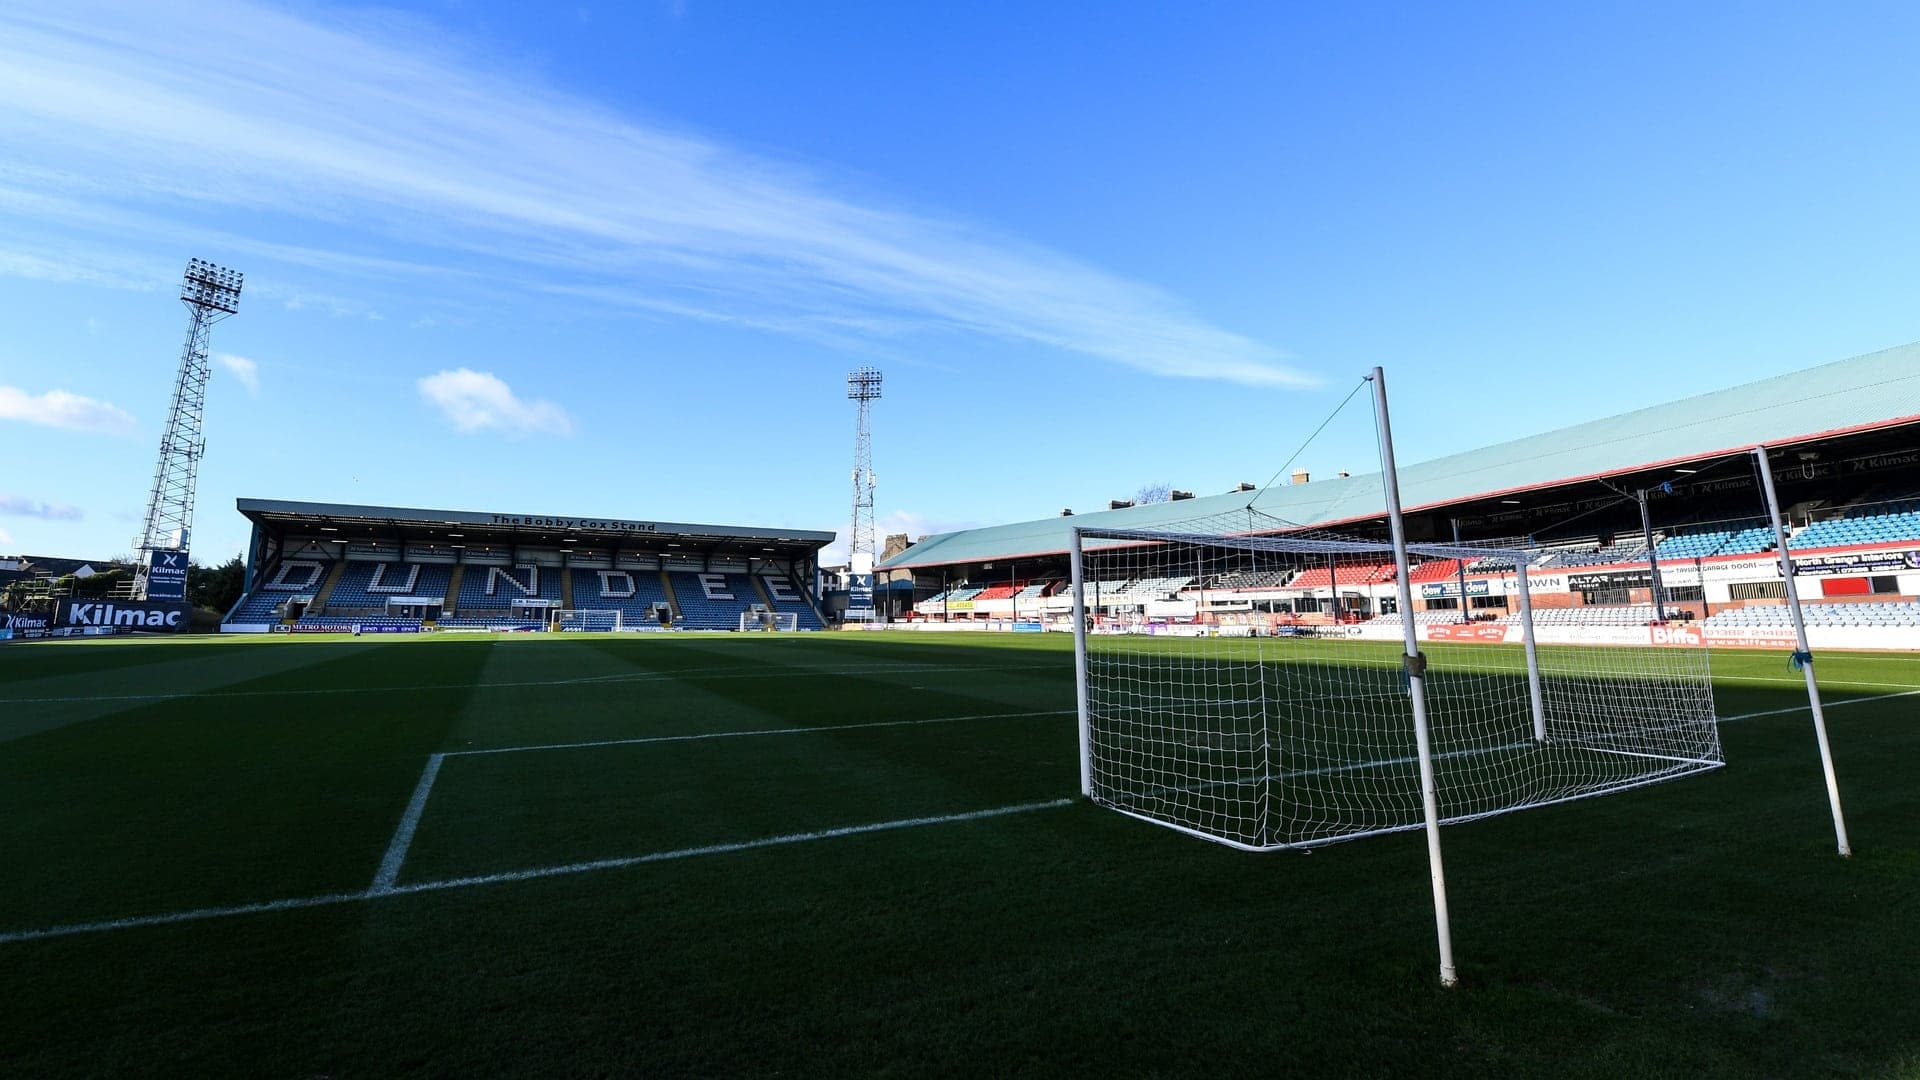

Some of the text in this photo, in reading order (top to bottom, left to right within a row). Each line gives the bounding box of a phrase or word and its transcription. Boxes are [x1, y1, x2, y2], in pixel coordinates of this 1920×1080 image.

[1870, 454, 1919, 468] Kilmac
[1786, 468, 1829, 480] Kilac
[1650, 488, 1685, 500] Kilac
[492, 515, 656, 531] The Bobby Cox Stand
[152, 566, 185, 575] Kilmac
[1465, 582, 1488, 593] dew
[69, 603, 181, 626] Kilmac
[15, 617, 47, 628] Kilmac
[1653, 627, 1699, 644] Biffa
